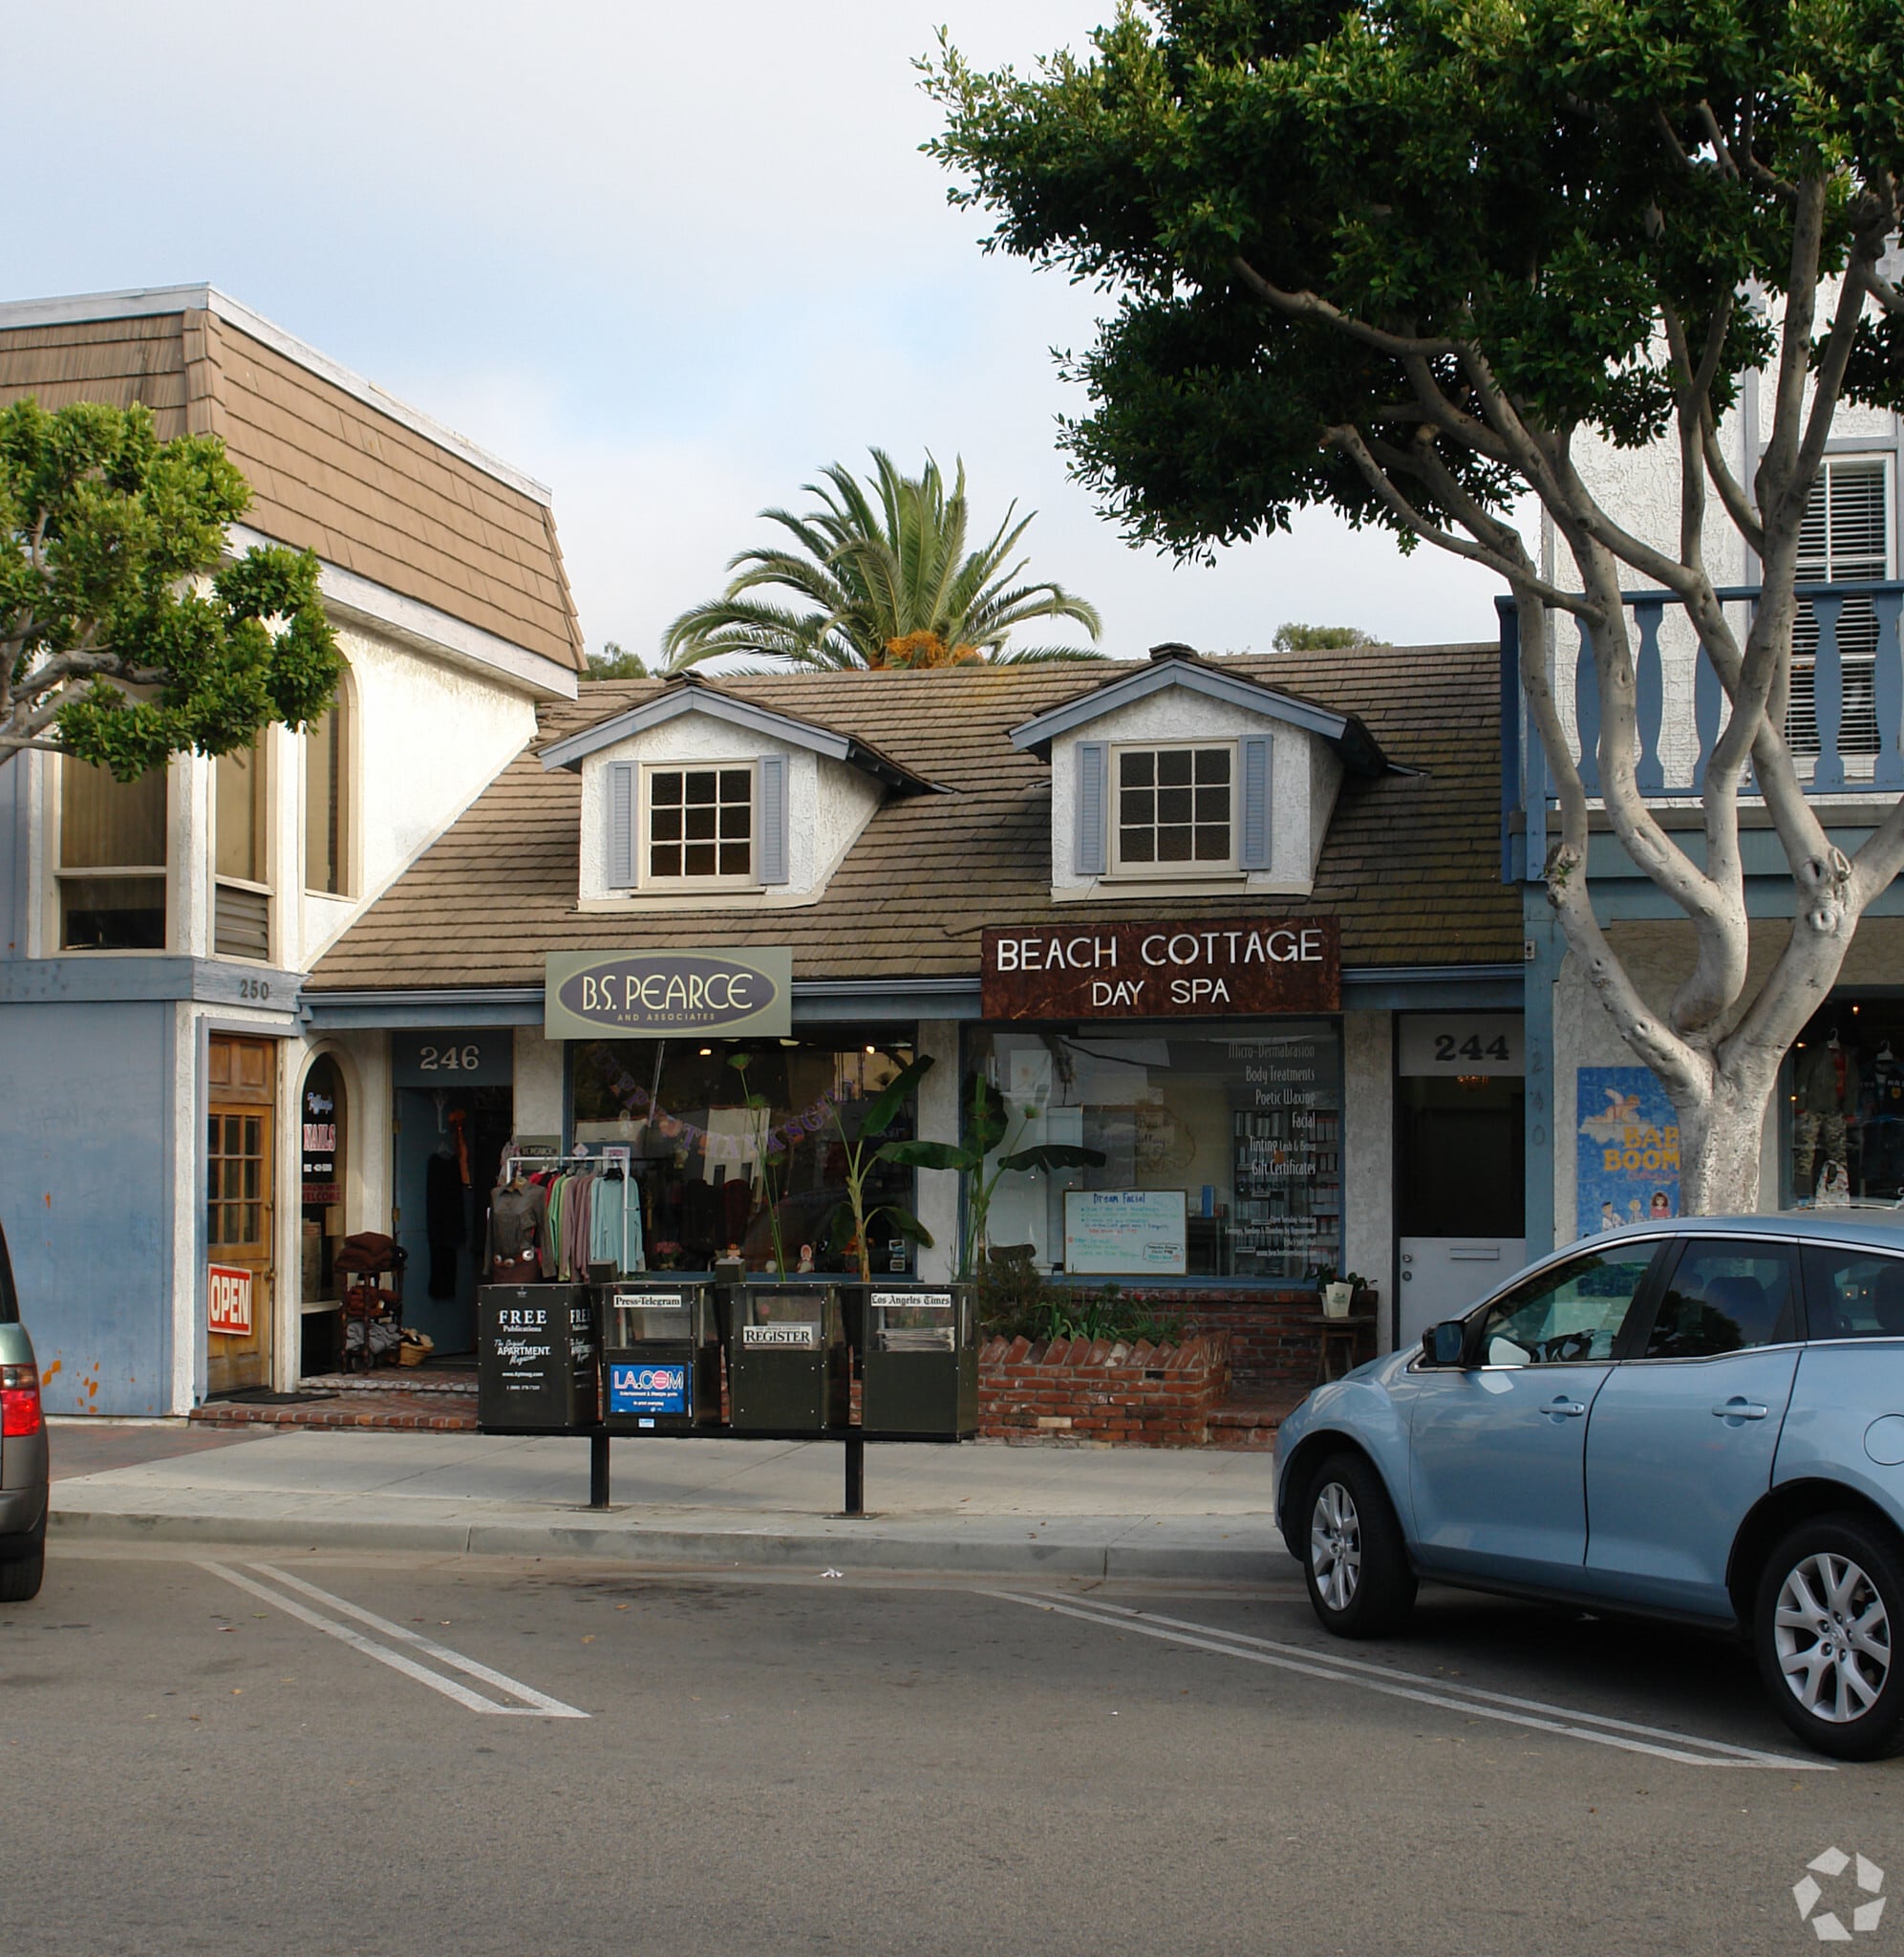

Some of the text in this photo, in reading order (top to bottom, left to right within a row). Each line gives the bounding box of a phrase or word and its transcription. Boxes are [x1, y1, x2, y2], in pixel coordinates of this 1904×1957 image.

[997, 929, 1323, 972] BEACH COTTAGE
[240, 978, 269, 1000] 250
[626, 973, 754, 1010] PEARCE
[1092, 978, 1230, 1007] DAY SPA
[646, 1013, 716, 1022] ASSOCIATES
[419, 1044, 480, 1070] 246
[1435, 1034, 1509, 1061] 244
[1246, 1065, 1316, 1085] Body Treatments
[1255, 1088, 1316, 1108] Poetic Waxing
[1292, 1111, 1316, 1129] Facial
[303, 1124, 336, 1151] NAILS
[1249, 1135, 1278, 1154] Tinting
[1252, 1158, 1316, 1175] Gift Certificates
[1603, 1149, 1680, 1171] BOOM
[1093, 1193, 1145, 1204] Dream Facial
[211, 1274, 249, 1324] OPEN
[615, 1296, 680, 1306] Press-Telegram
[871, 1294, 951, 1307] Los Angeles Times
[499, 1309, 547, 1324] FREE
[745, 1329, 810, 1343] REGISTER
[497, 1345, 551, 1356] APARTMENT
